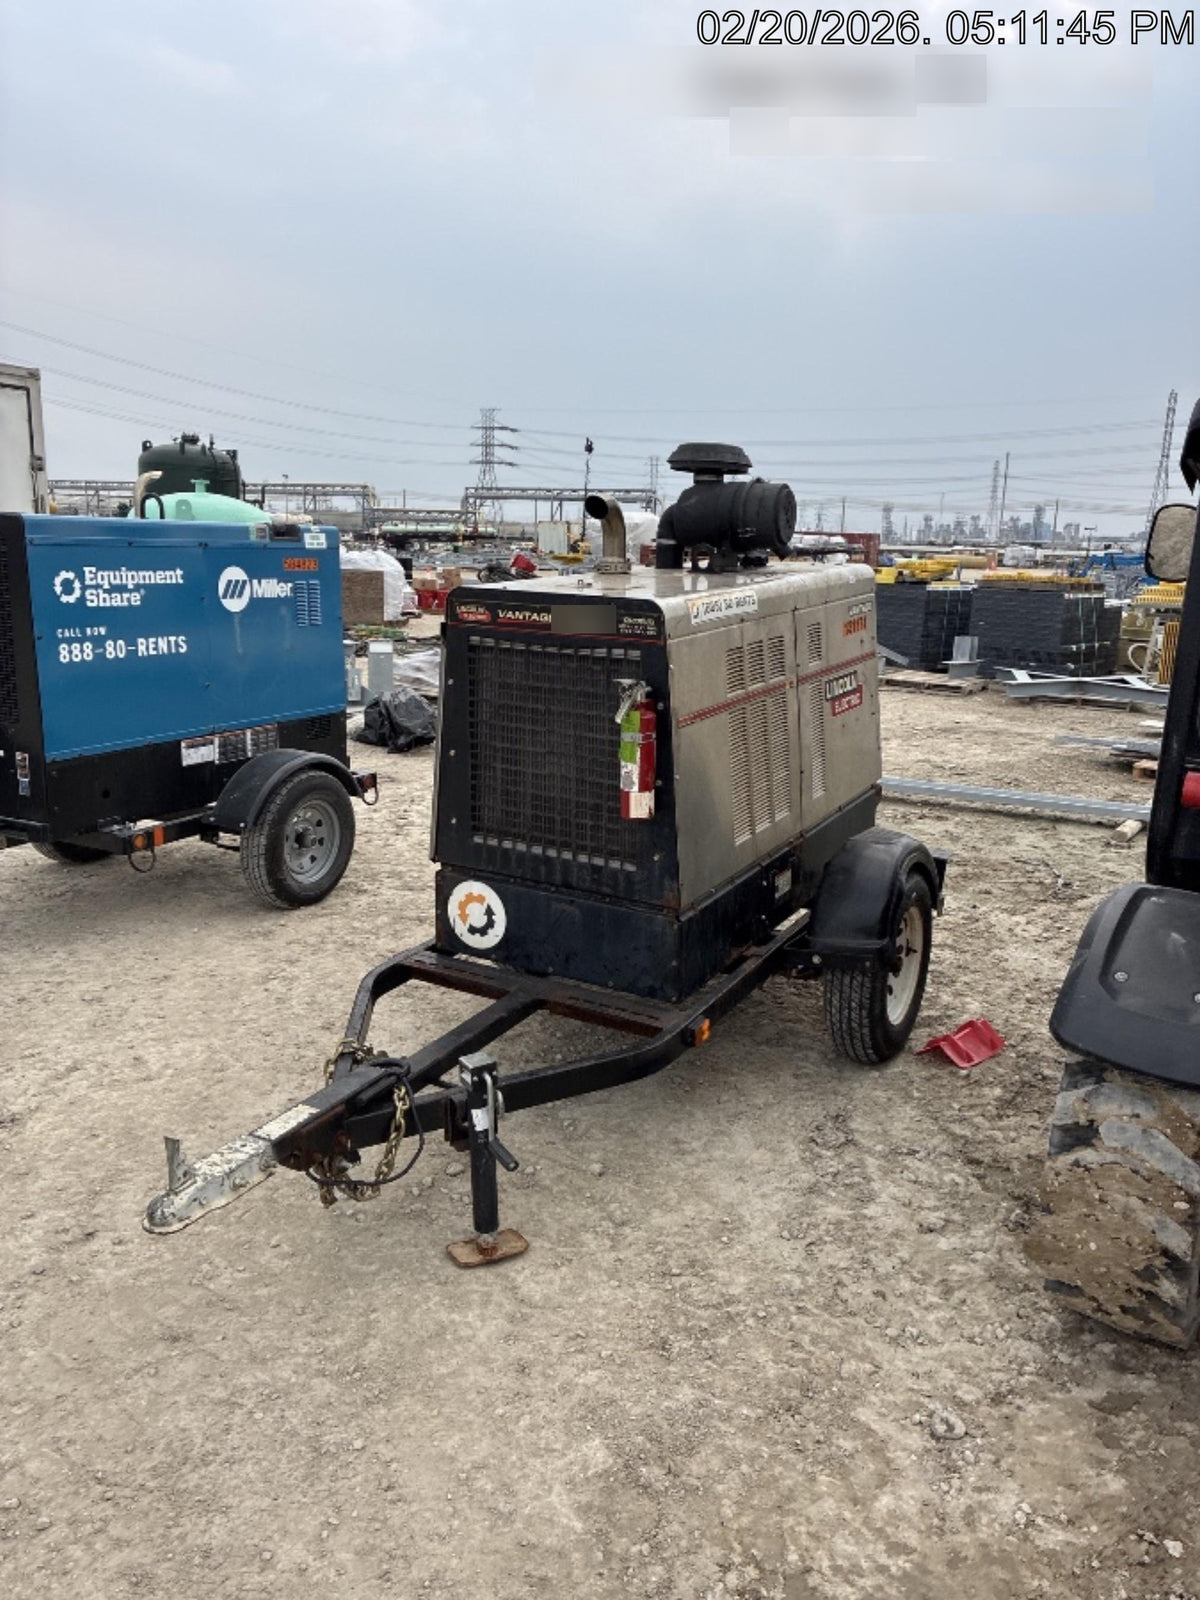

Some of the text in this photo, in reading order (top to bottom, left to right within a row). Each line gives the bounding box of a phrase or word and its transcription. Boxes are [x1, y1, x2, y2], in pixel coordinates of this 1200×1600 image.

[83, 566, 184, 589] Equipment
[85, 588, 141, 607] Share
[252, 578, 293, 598] Miller
[56, 627, 107, 638] CALL NOW
[58, 636, 188, 663] 888-80-RENTS
